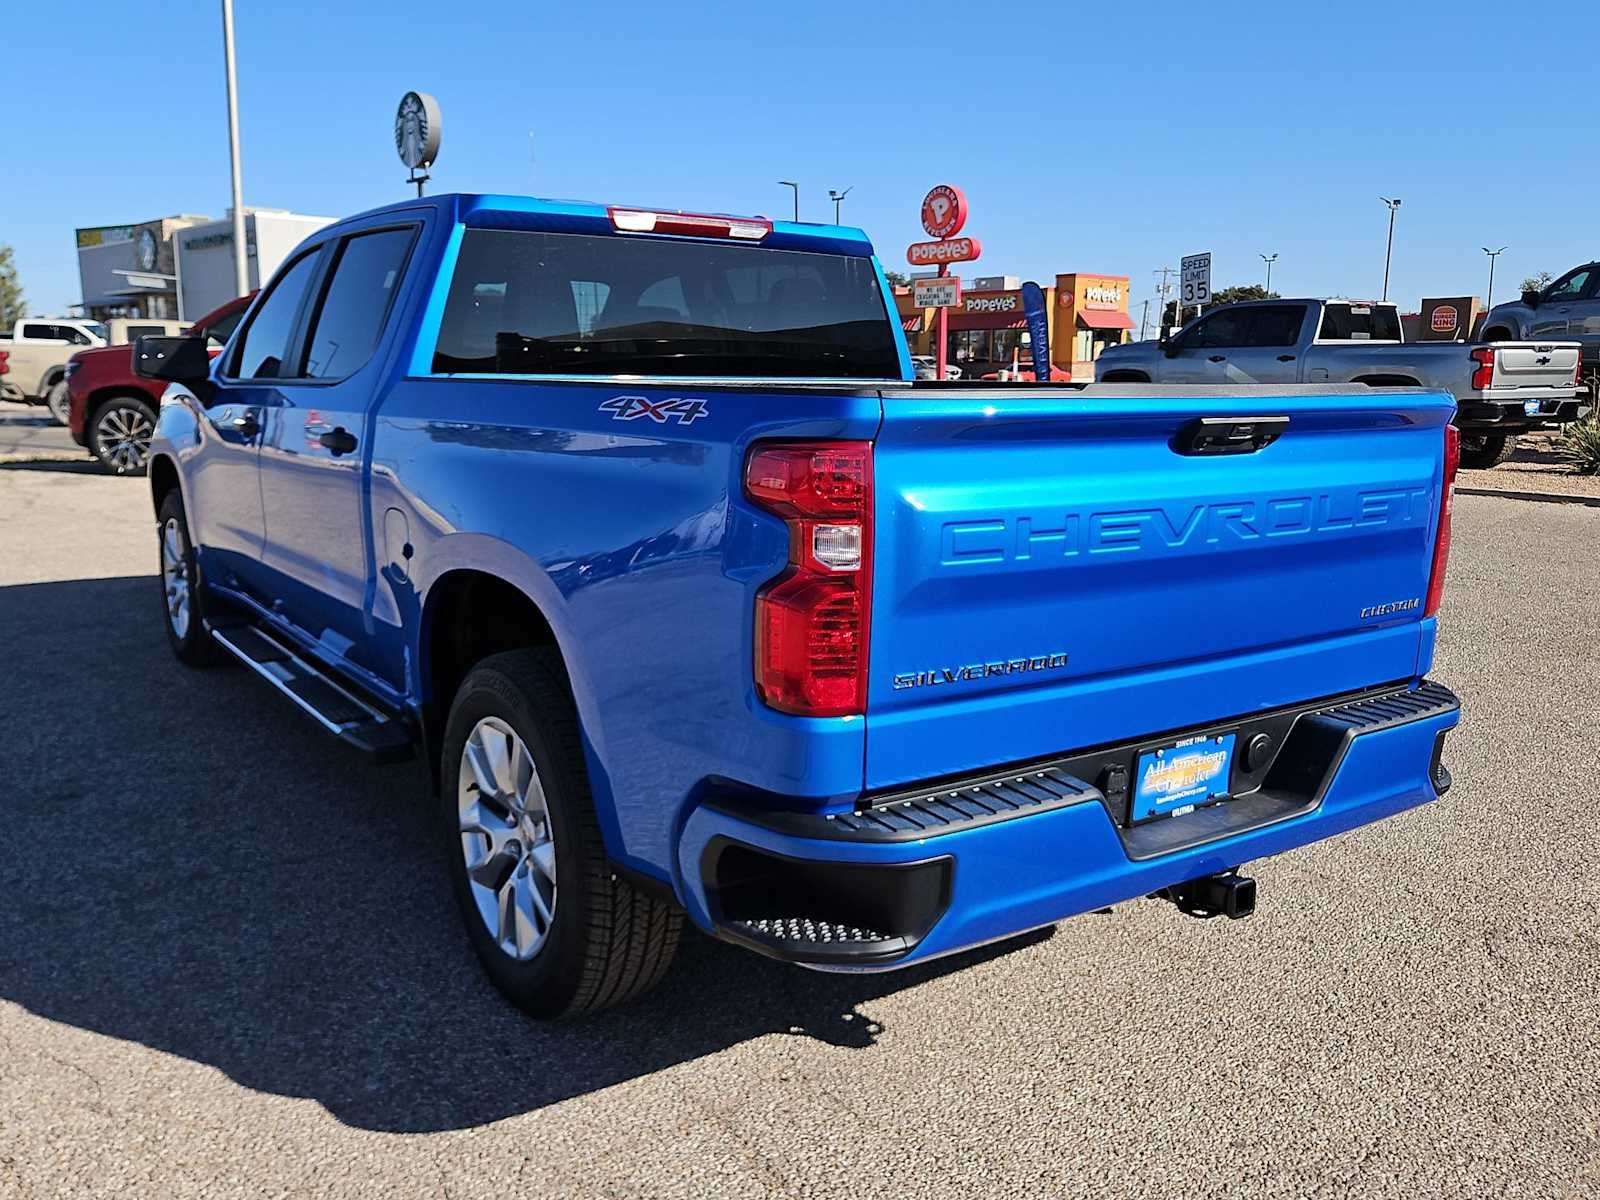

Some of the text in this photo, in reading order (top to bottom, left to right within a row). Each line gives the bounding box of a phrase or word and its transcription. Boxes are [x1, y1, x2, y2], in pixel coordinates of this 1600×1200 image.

[930, 197, 951, 224] P
[1182, 258, 1209, 271] SPEED
[1185, 269, 1207, 282] LIMIT
[1184, 281, 1207, 301] 35
[1433, 317, 1456, 328] KING
[941, 487, 1426, 565] CHEVROLET
[1360, 598, 1420, 618] CUSTOM
[892, 652, 1068, 691] SILVERADO
[1176, 738, 1193, 748] SINCE
[1144, 751, 1226, 779] All American
